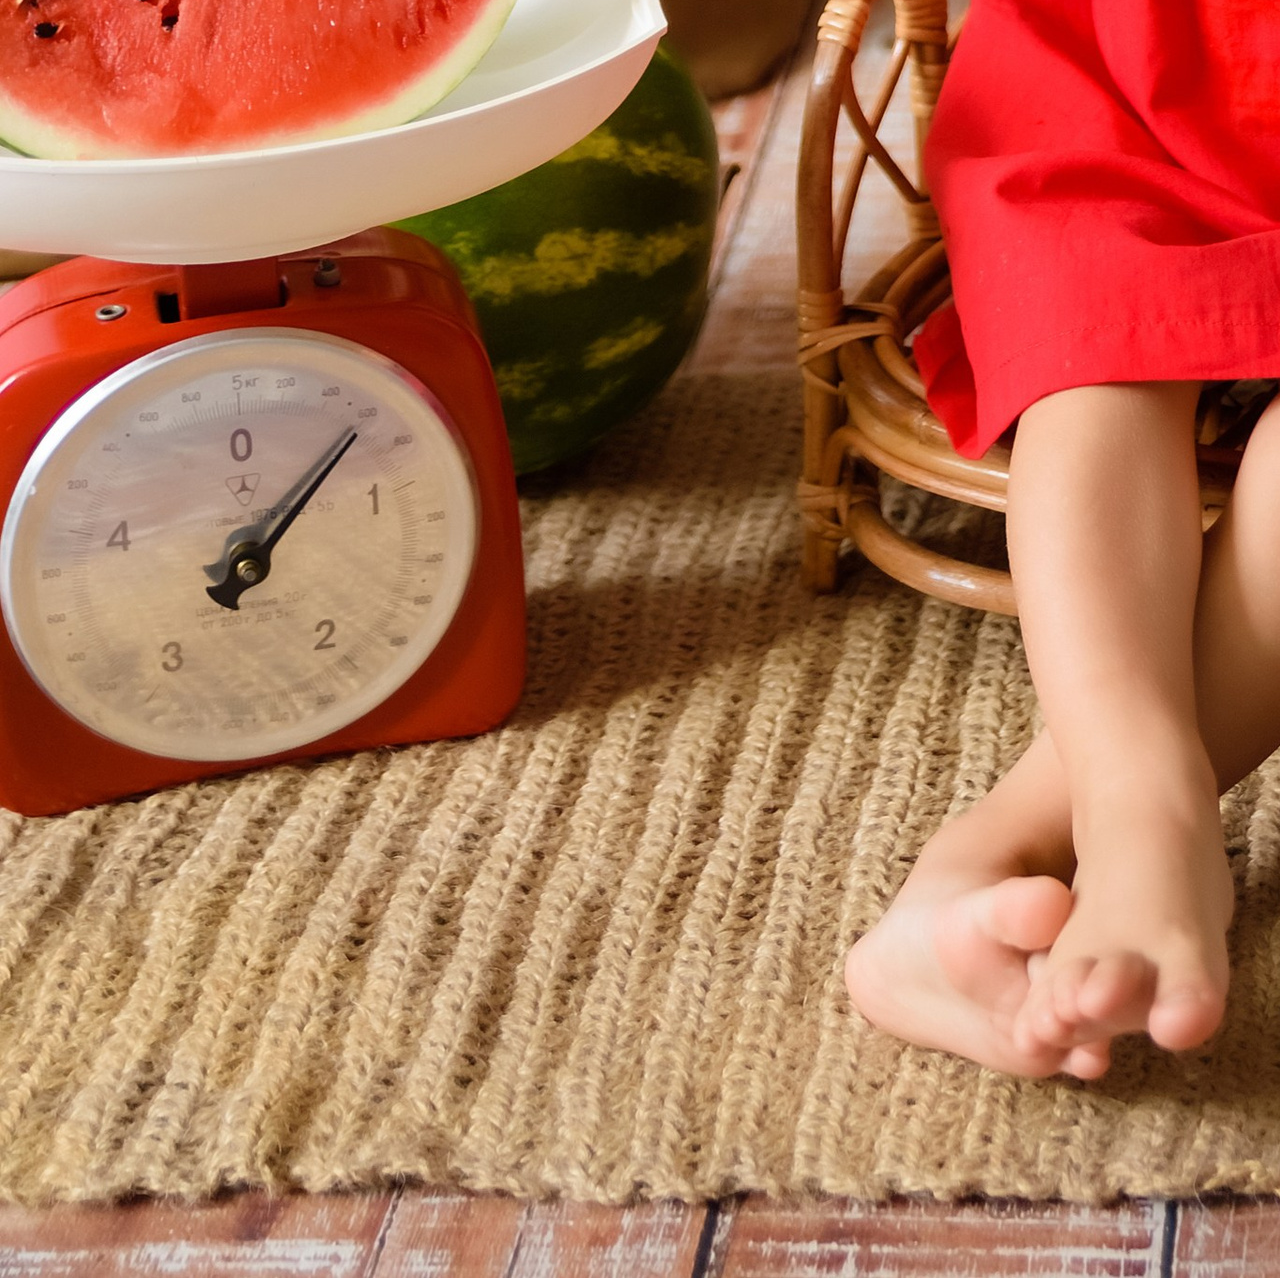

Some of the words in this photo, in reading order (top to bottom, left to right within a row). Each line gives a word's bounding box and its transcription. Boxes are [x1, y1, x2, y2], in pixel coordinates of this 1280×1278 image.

[275, 377, 296, 389] 200
[321, 386, 341, 398] 400
[180, 391, 202, 403] 800
[138, 411, 160, 423] 600
[358, 407, 378, 419] 600
[230, 428, 253, 462] 0
[367, 483, 379, 516] 1
[106, 520, 132, 552] 4
[314, 619, 337, 651] 2
[161, 641, 184, 673] 3
